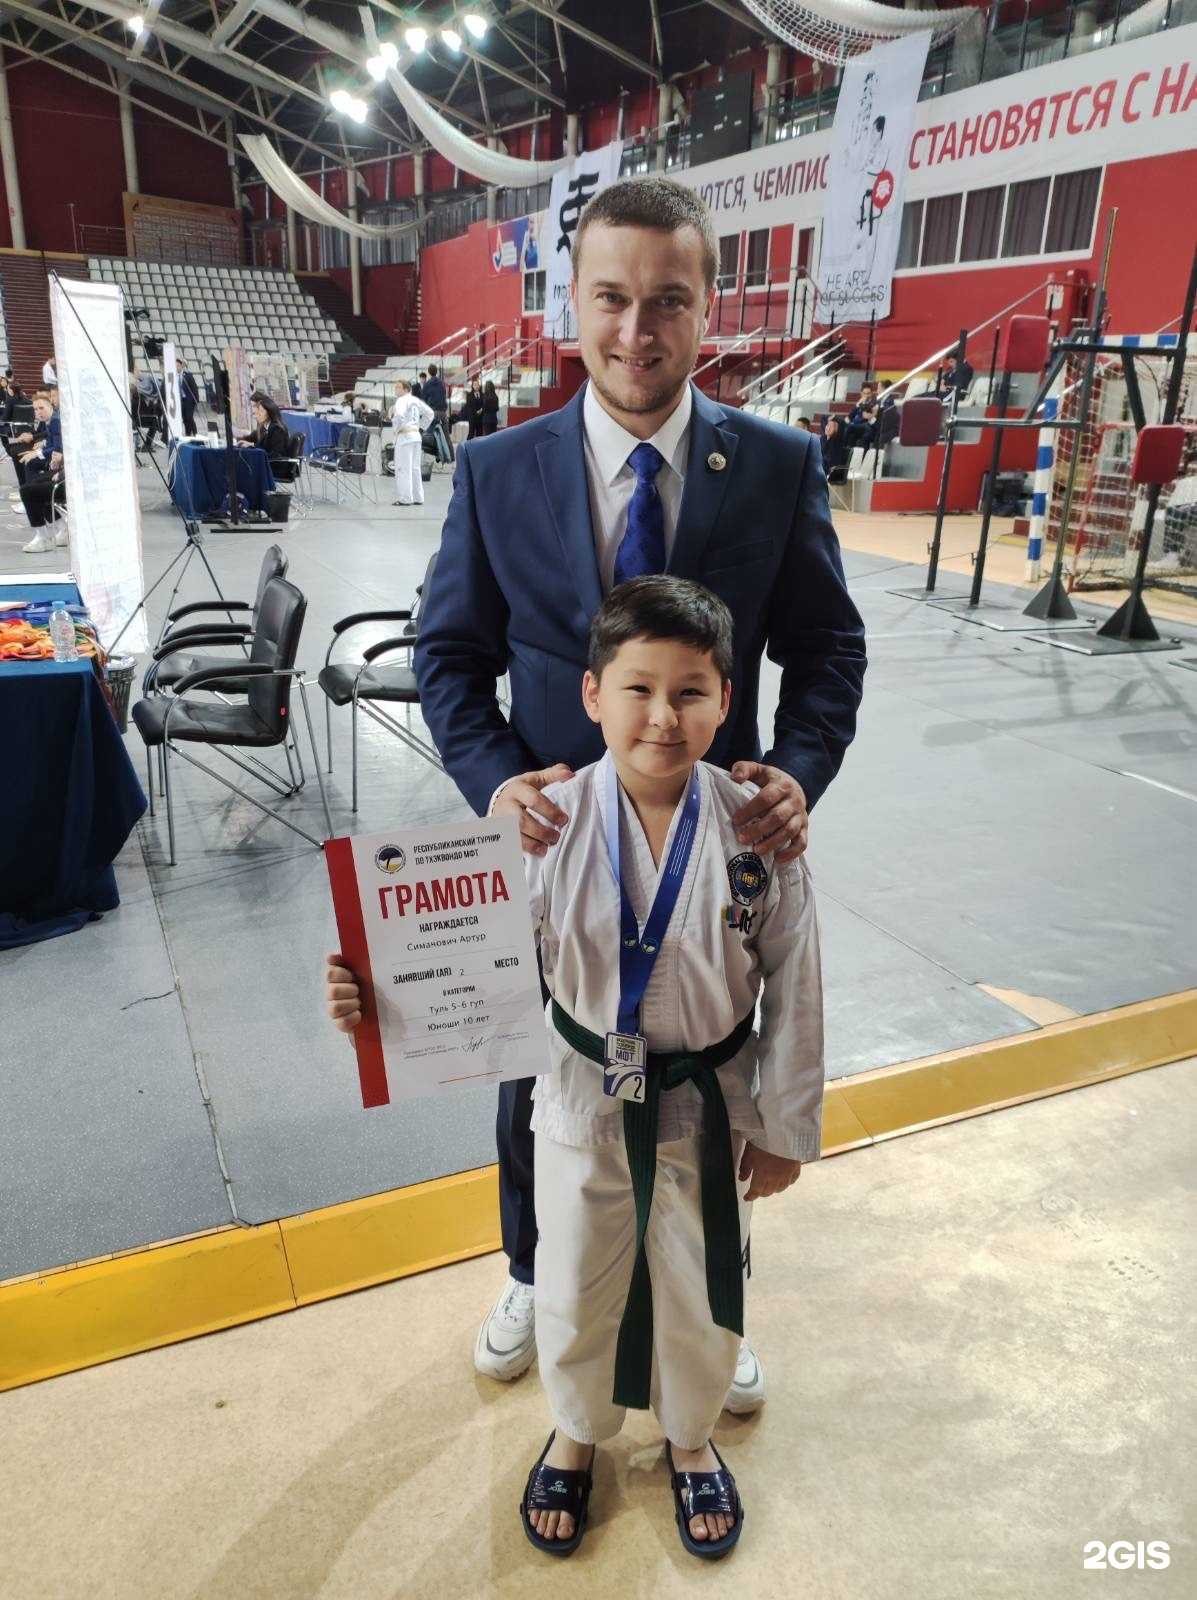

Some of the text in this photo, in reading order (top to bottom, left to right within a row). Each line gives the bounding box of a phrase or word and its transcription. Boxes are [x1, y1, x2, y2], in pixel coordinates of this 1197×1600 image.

[908, 79, 1118, 170] СТАНОВЯТСЯ
[1122, 71, 1151, 123] С
[839, 284, 888, 306] SUCCES
[413, 833, 501, 854] РЕСПУБЛИКАНСКИЙ ТУРНИР
[415, 848, 479, 866] ПО ТХЭКВОНДО МФТ
[378, 870, 510, 919] ГРАМОТА
[419, 915, 479, 933] НАГРАЖДАЕТСЯ
[407, 933, 486, 952] Симанович Артур
[393, 956, 519, 985] ЗАНЯВШИЙ (АЯ) 2 МЕСТО
[447, 985, 476, 996] КАТЕГОРИИ
[429, 1006, 449, 1016] Туль
[470, 999, 484, 1009] гуп
[427, 1015, 490, 1031] Юноши 10 лет
[633, 1076, 643, 1100] 2
